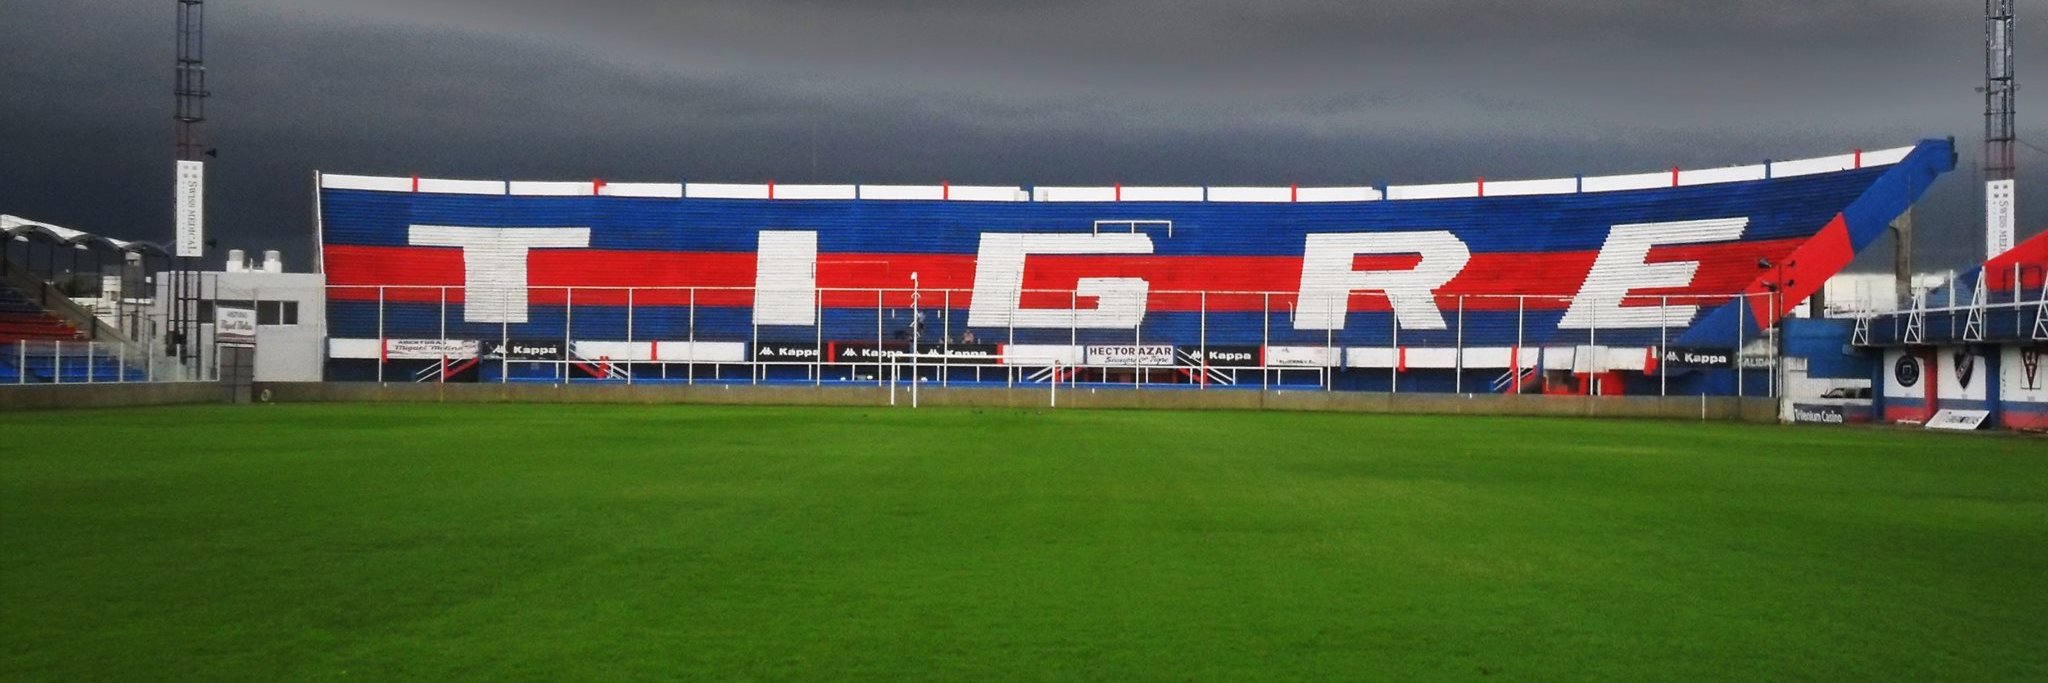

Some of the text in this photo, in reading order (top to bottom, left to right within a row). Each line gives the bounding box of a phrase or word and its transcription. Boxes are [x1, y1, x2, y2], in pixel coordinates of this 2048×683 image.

[408, 217, 1749, 330] TIGRE
[513, 345, 557, 356] Kappa
[778, 347, 820, 358] Kappa
[861, 348, 904, 358] Kappa
[1090, 347, 1172, 355] HECTOR AZAR
[1208, 351, 1251, 361] Kappa
[1684, 352, 1727, 365] Kappa
[1821, 410, 1843, 423] Casino
